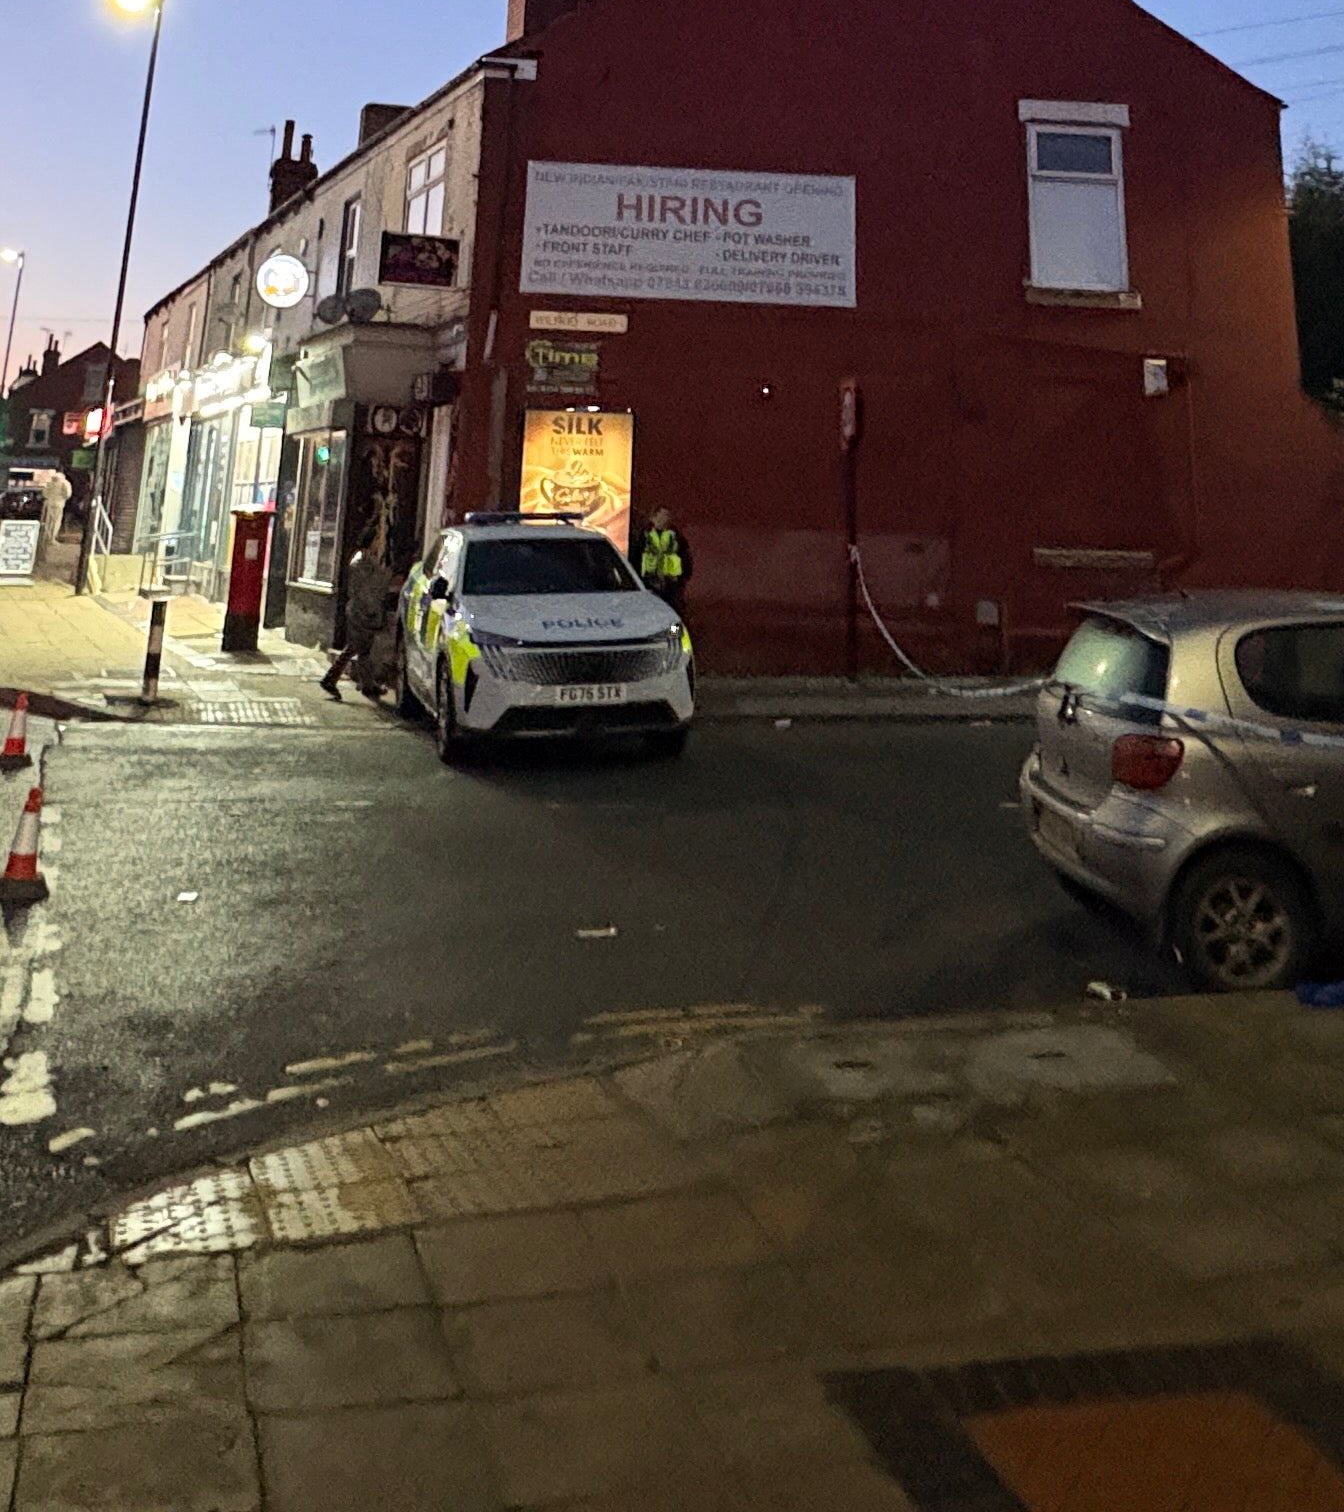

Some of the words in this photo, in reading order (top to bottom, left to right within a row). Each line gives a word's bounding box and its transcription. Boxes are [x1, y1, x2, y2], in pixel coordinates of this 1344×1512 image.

[616, 192, 763, 228] HIRING
[673, 229, 712, 243] CHEF
[723, 231, 750, 245] POT
[753, 233, 810, 248] WASHER
[542, 241, 588, 254] FRONT
[592, 242, 632, 256] STAFF
[723, 249, 787, 263] DELIVERY
[790, 251, 840, 266] DRIVER
[552, 414, 603, 436] SILK
[573, 448, 604, 456] WARM
[542, 617, 625, 630] POLICE
